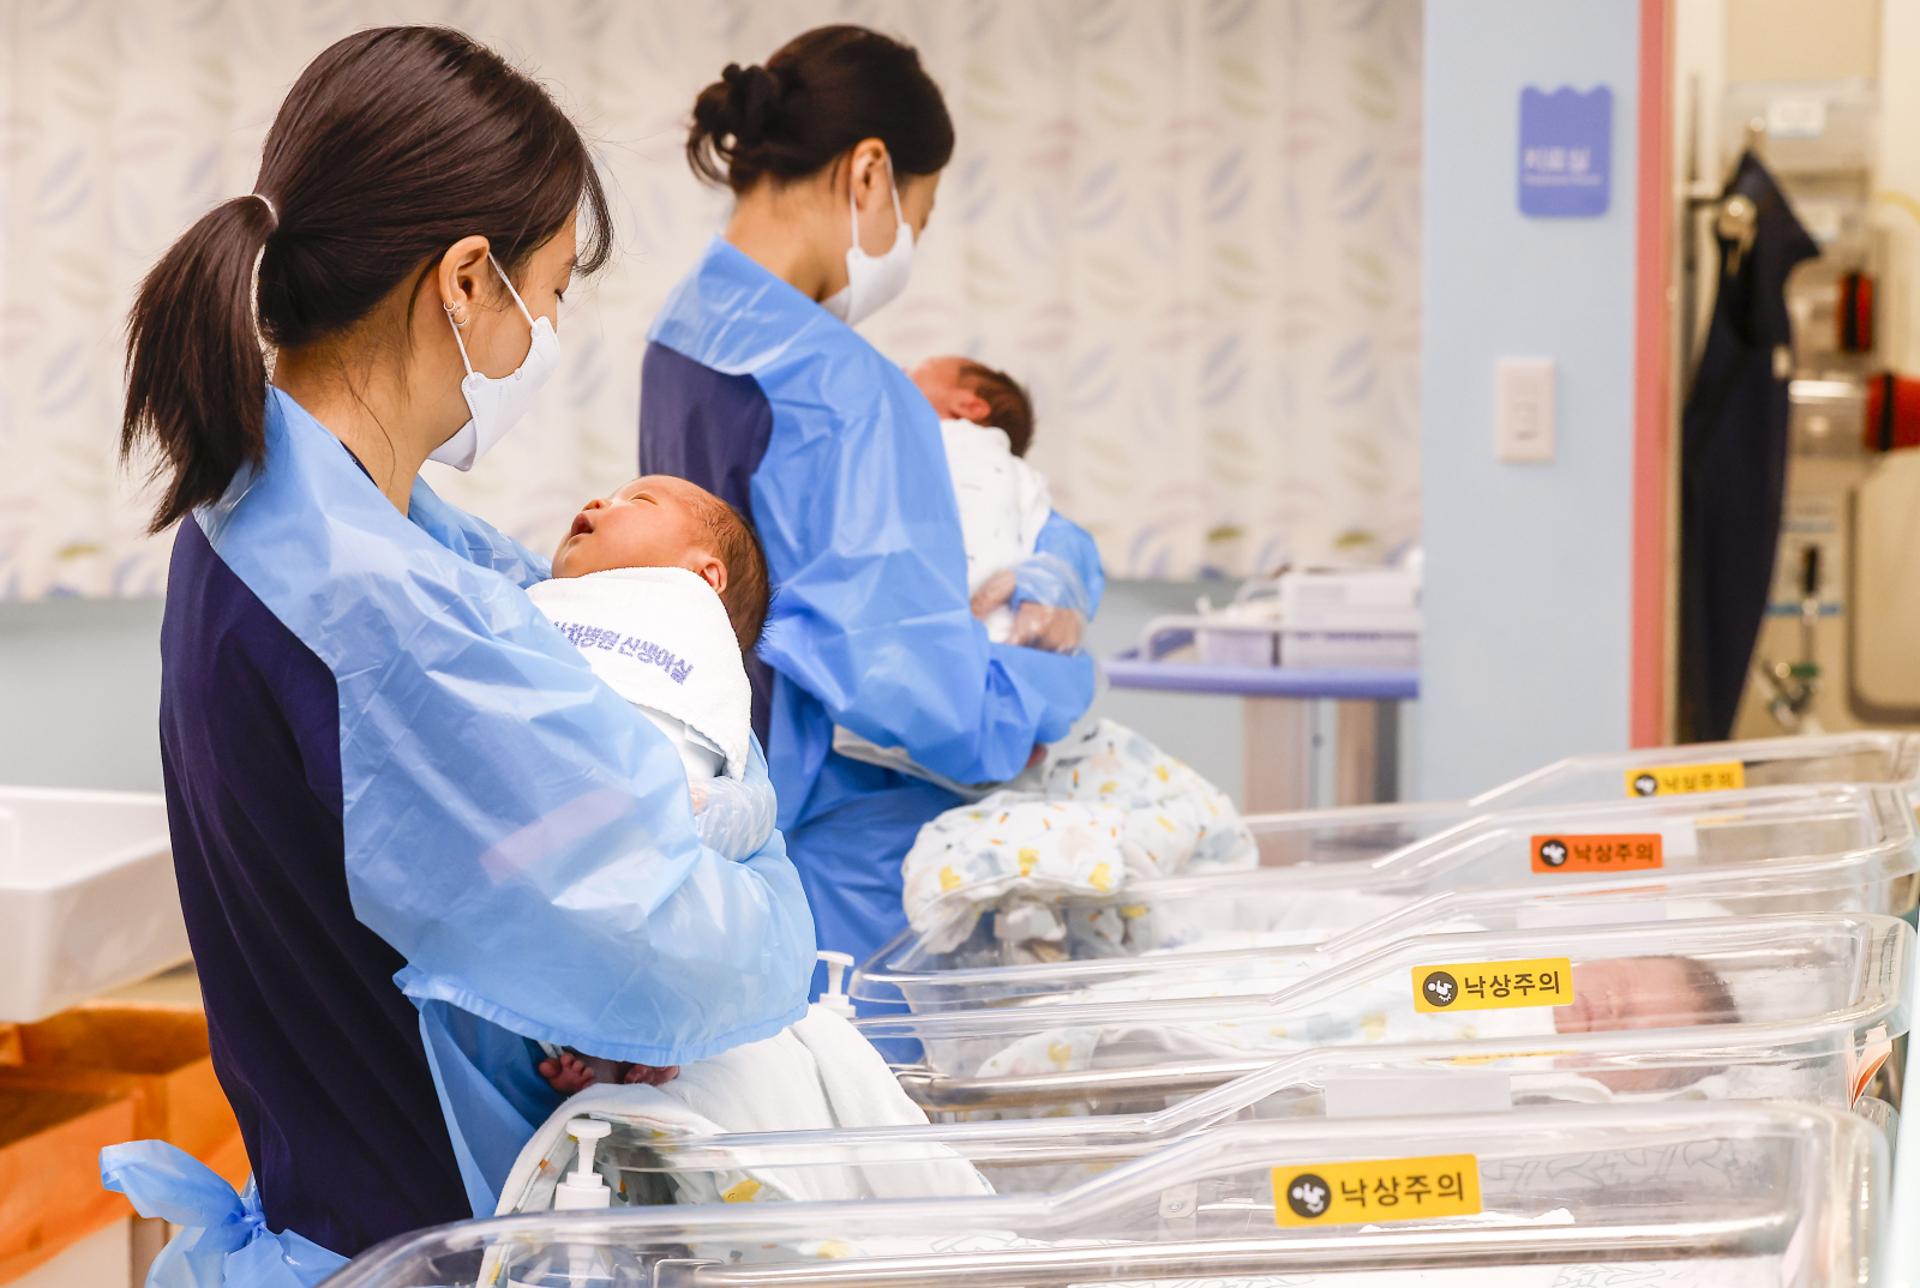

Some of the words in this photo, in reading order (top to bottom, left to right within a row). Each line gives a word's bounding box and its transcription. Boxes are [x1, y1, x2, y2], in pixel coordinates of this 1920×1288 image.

[618, 637, 693, 685] 신생아실
[1663, 772, 1736, 792] 낙상주의
[1573, 842, 1654, 863] 낙상주의
[1464, 971, 1560, 999] 낙상주의
[1340, 1172, 1464, 1208] 낙상주의
